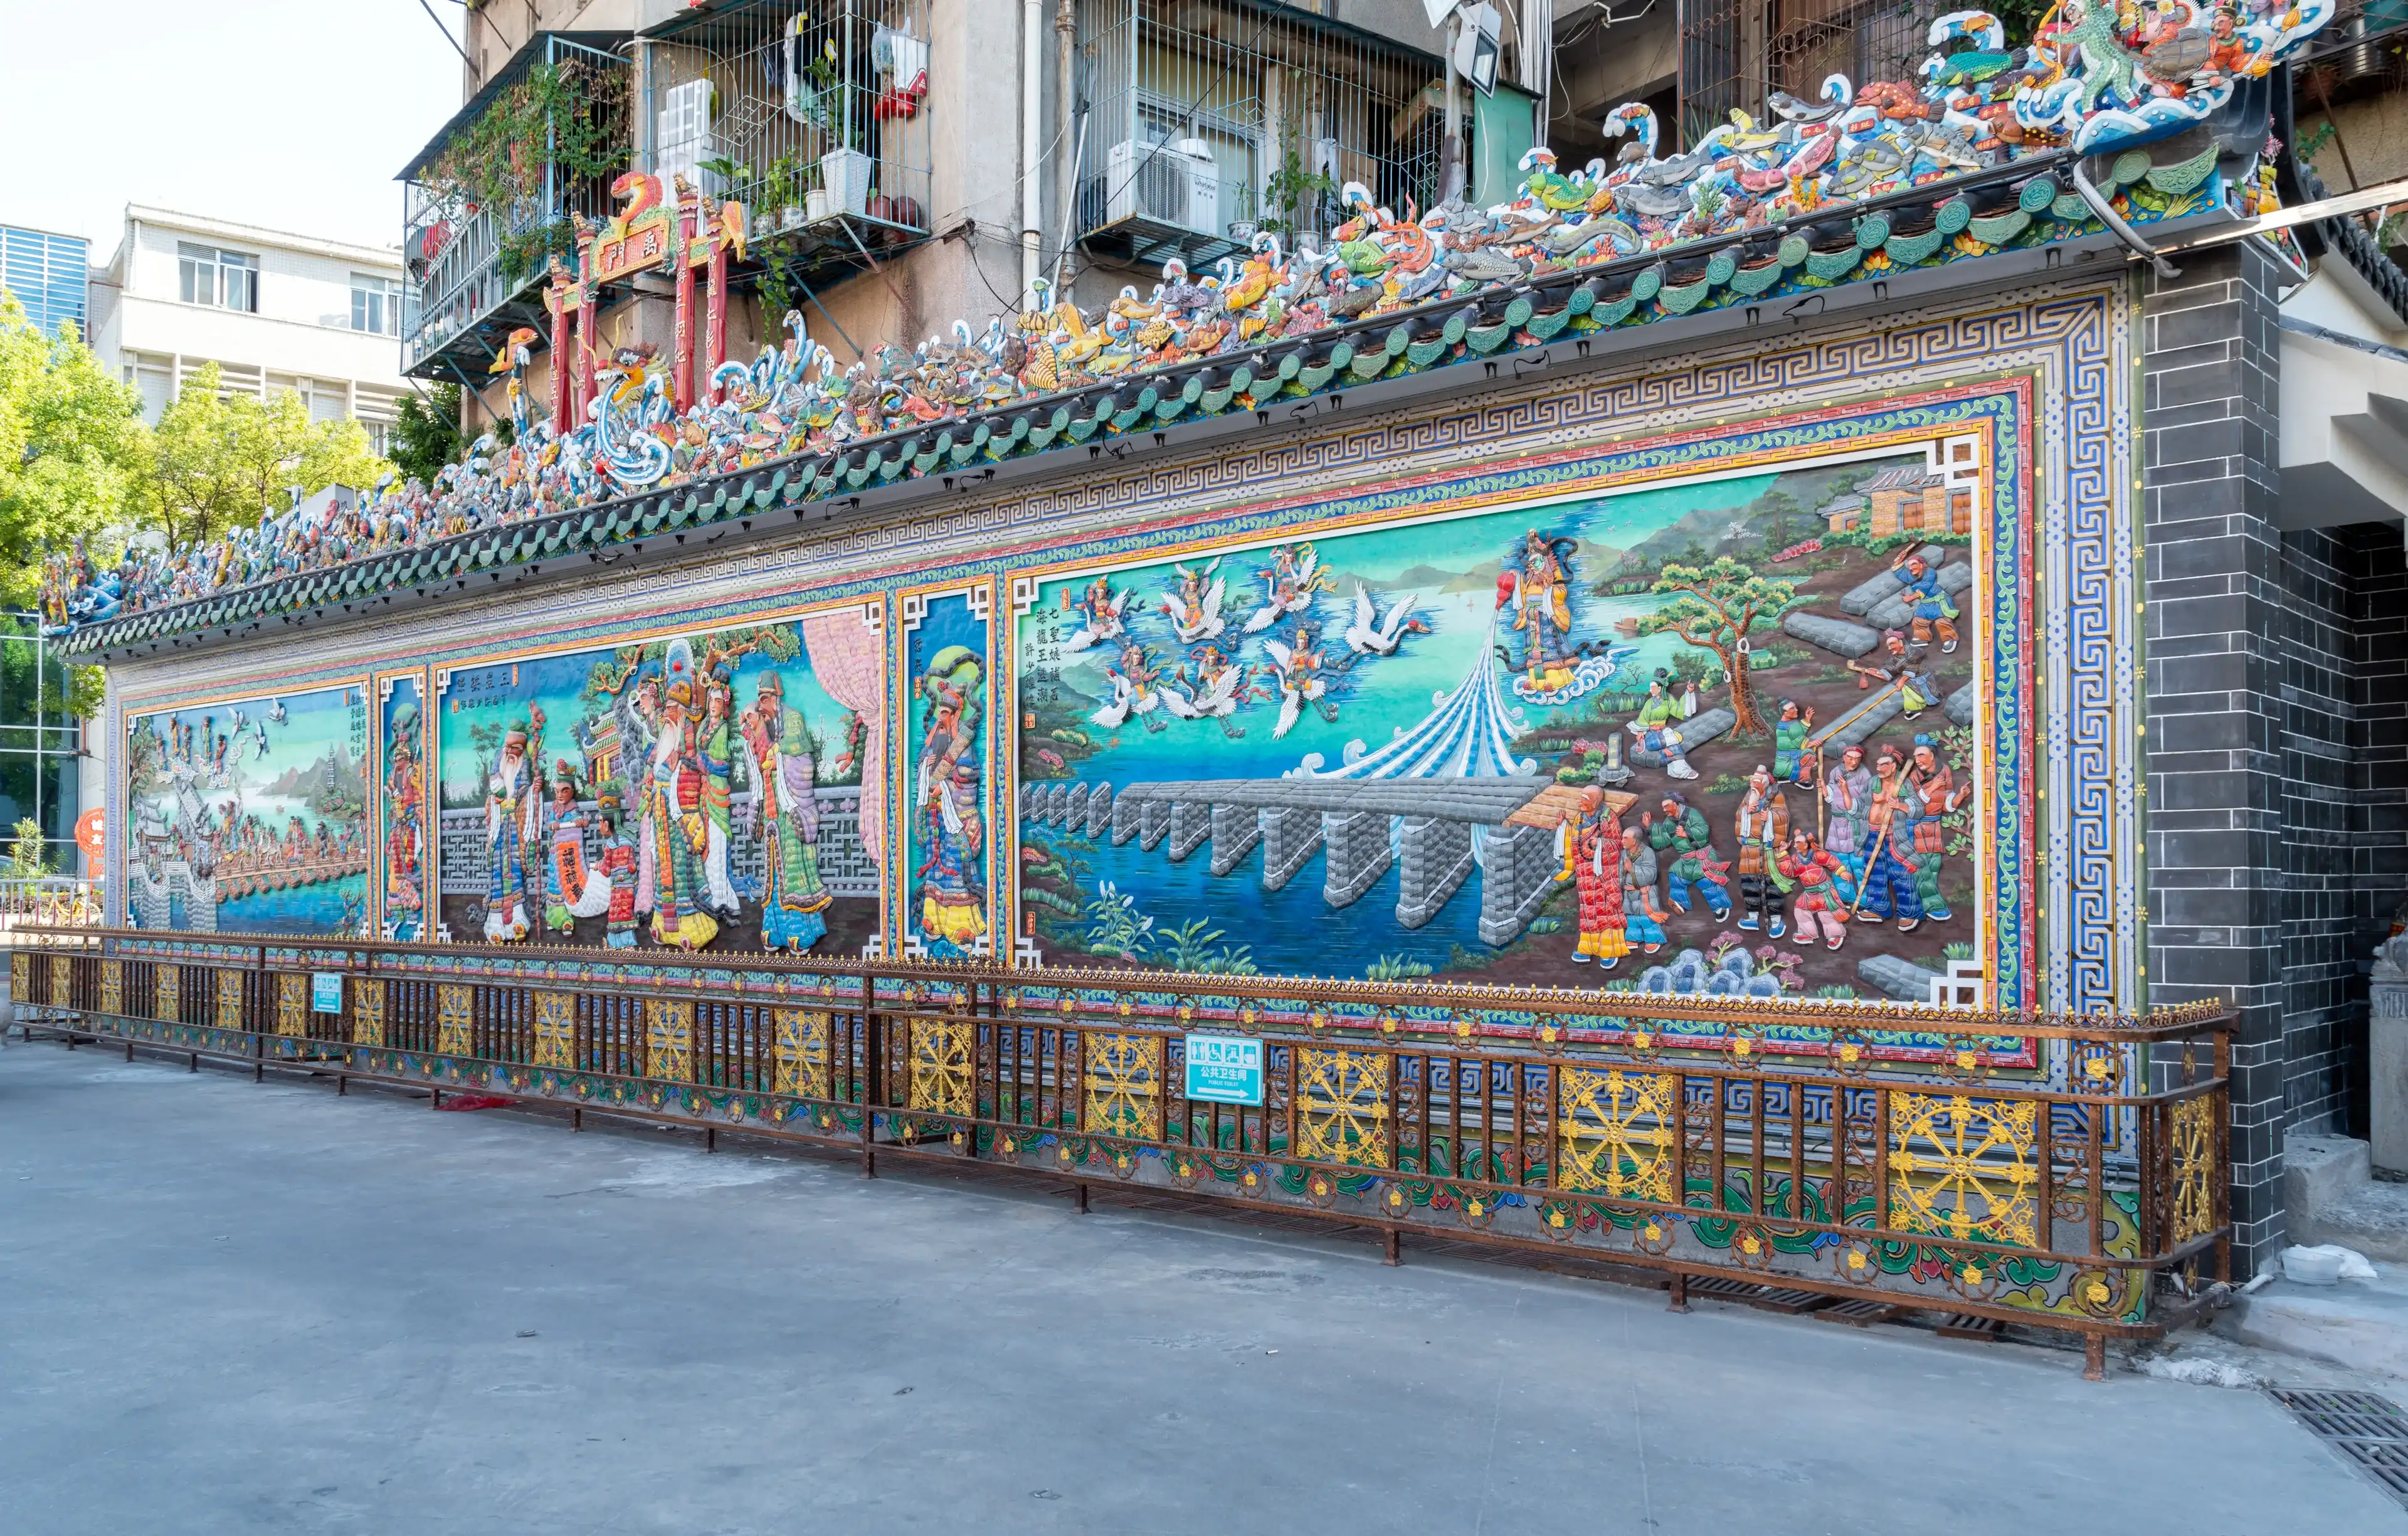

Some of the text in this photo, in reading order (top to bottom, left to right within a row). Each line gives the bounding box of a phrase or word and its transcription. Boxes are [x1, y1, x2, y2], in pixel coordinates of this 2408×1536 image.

[1200, 1066, 1247, 1081] 公共卫生间
